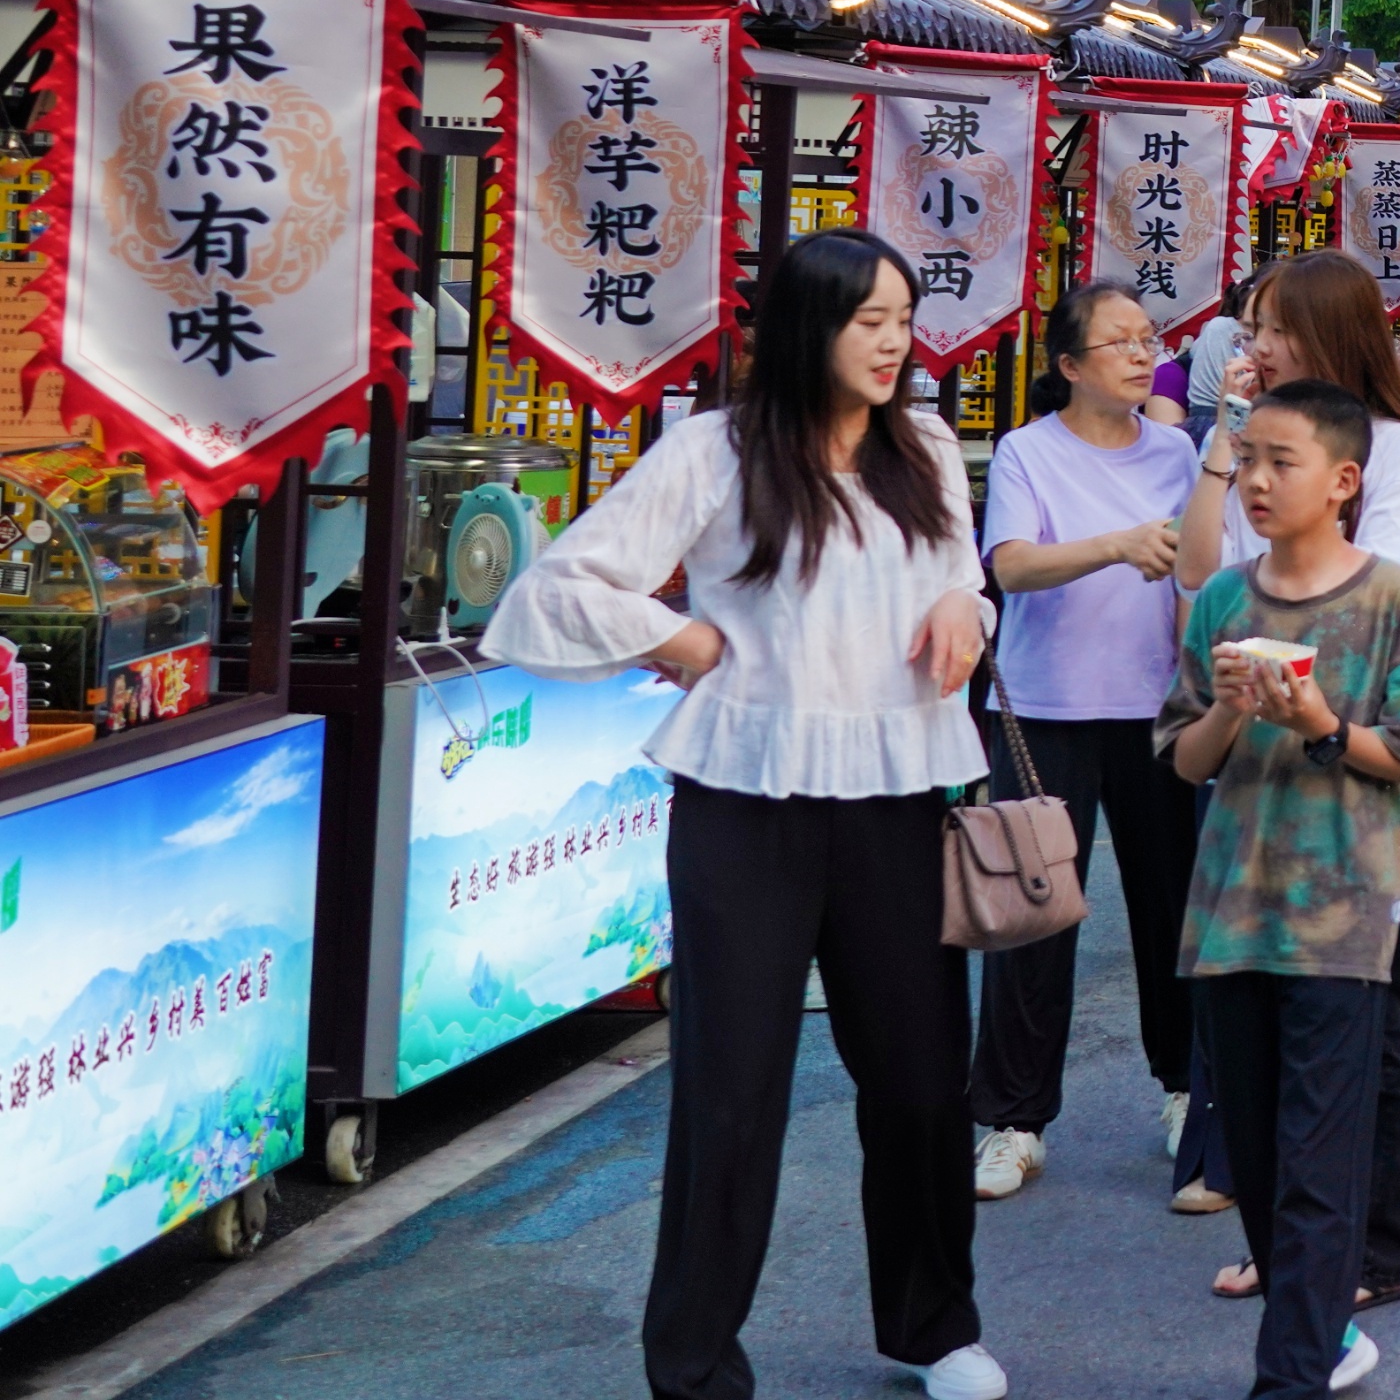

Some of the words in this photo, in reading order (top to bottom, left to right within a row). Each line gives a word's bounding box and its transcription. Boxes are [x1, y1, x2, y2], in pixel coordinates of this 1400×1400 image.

[164, 3, 287, 376] 果然有味
[579, 61, 661, 325] 洋芋粑粑
[919, 104, 985, 300] 辣小西
[1135, 130, 1189, 300] 时光米线
